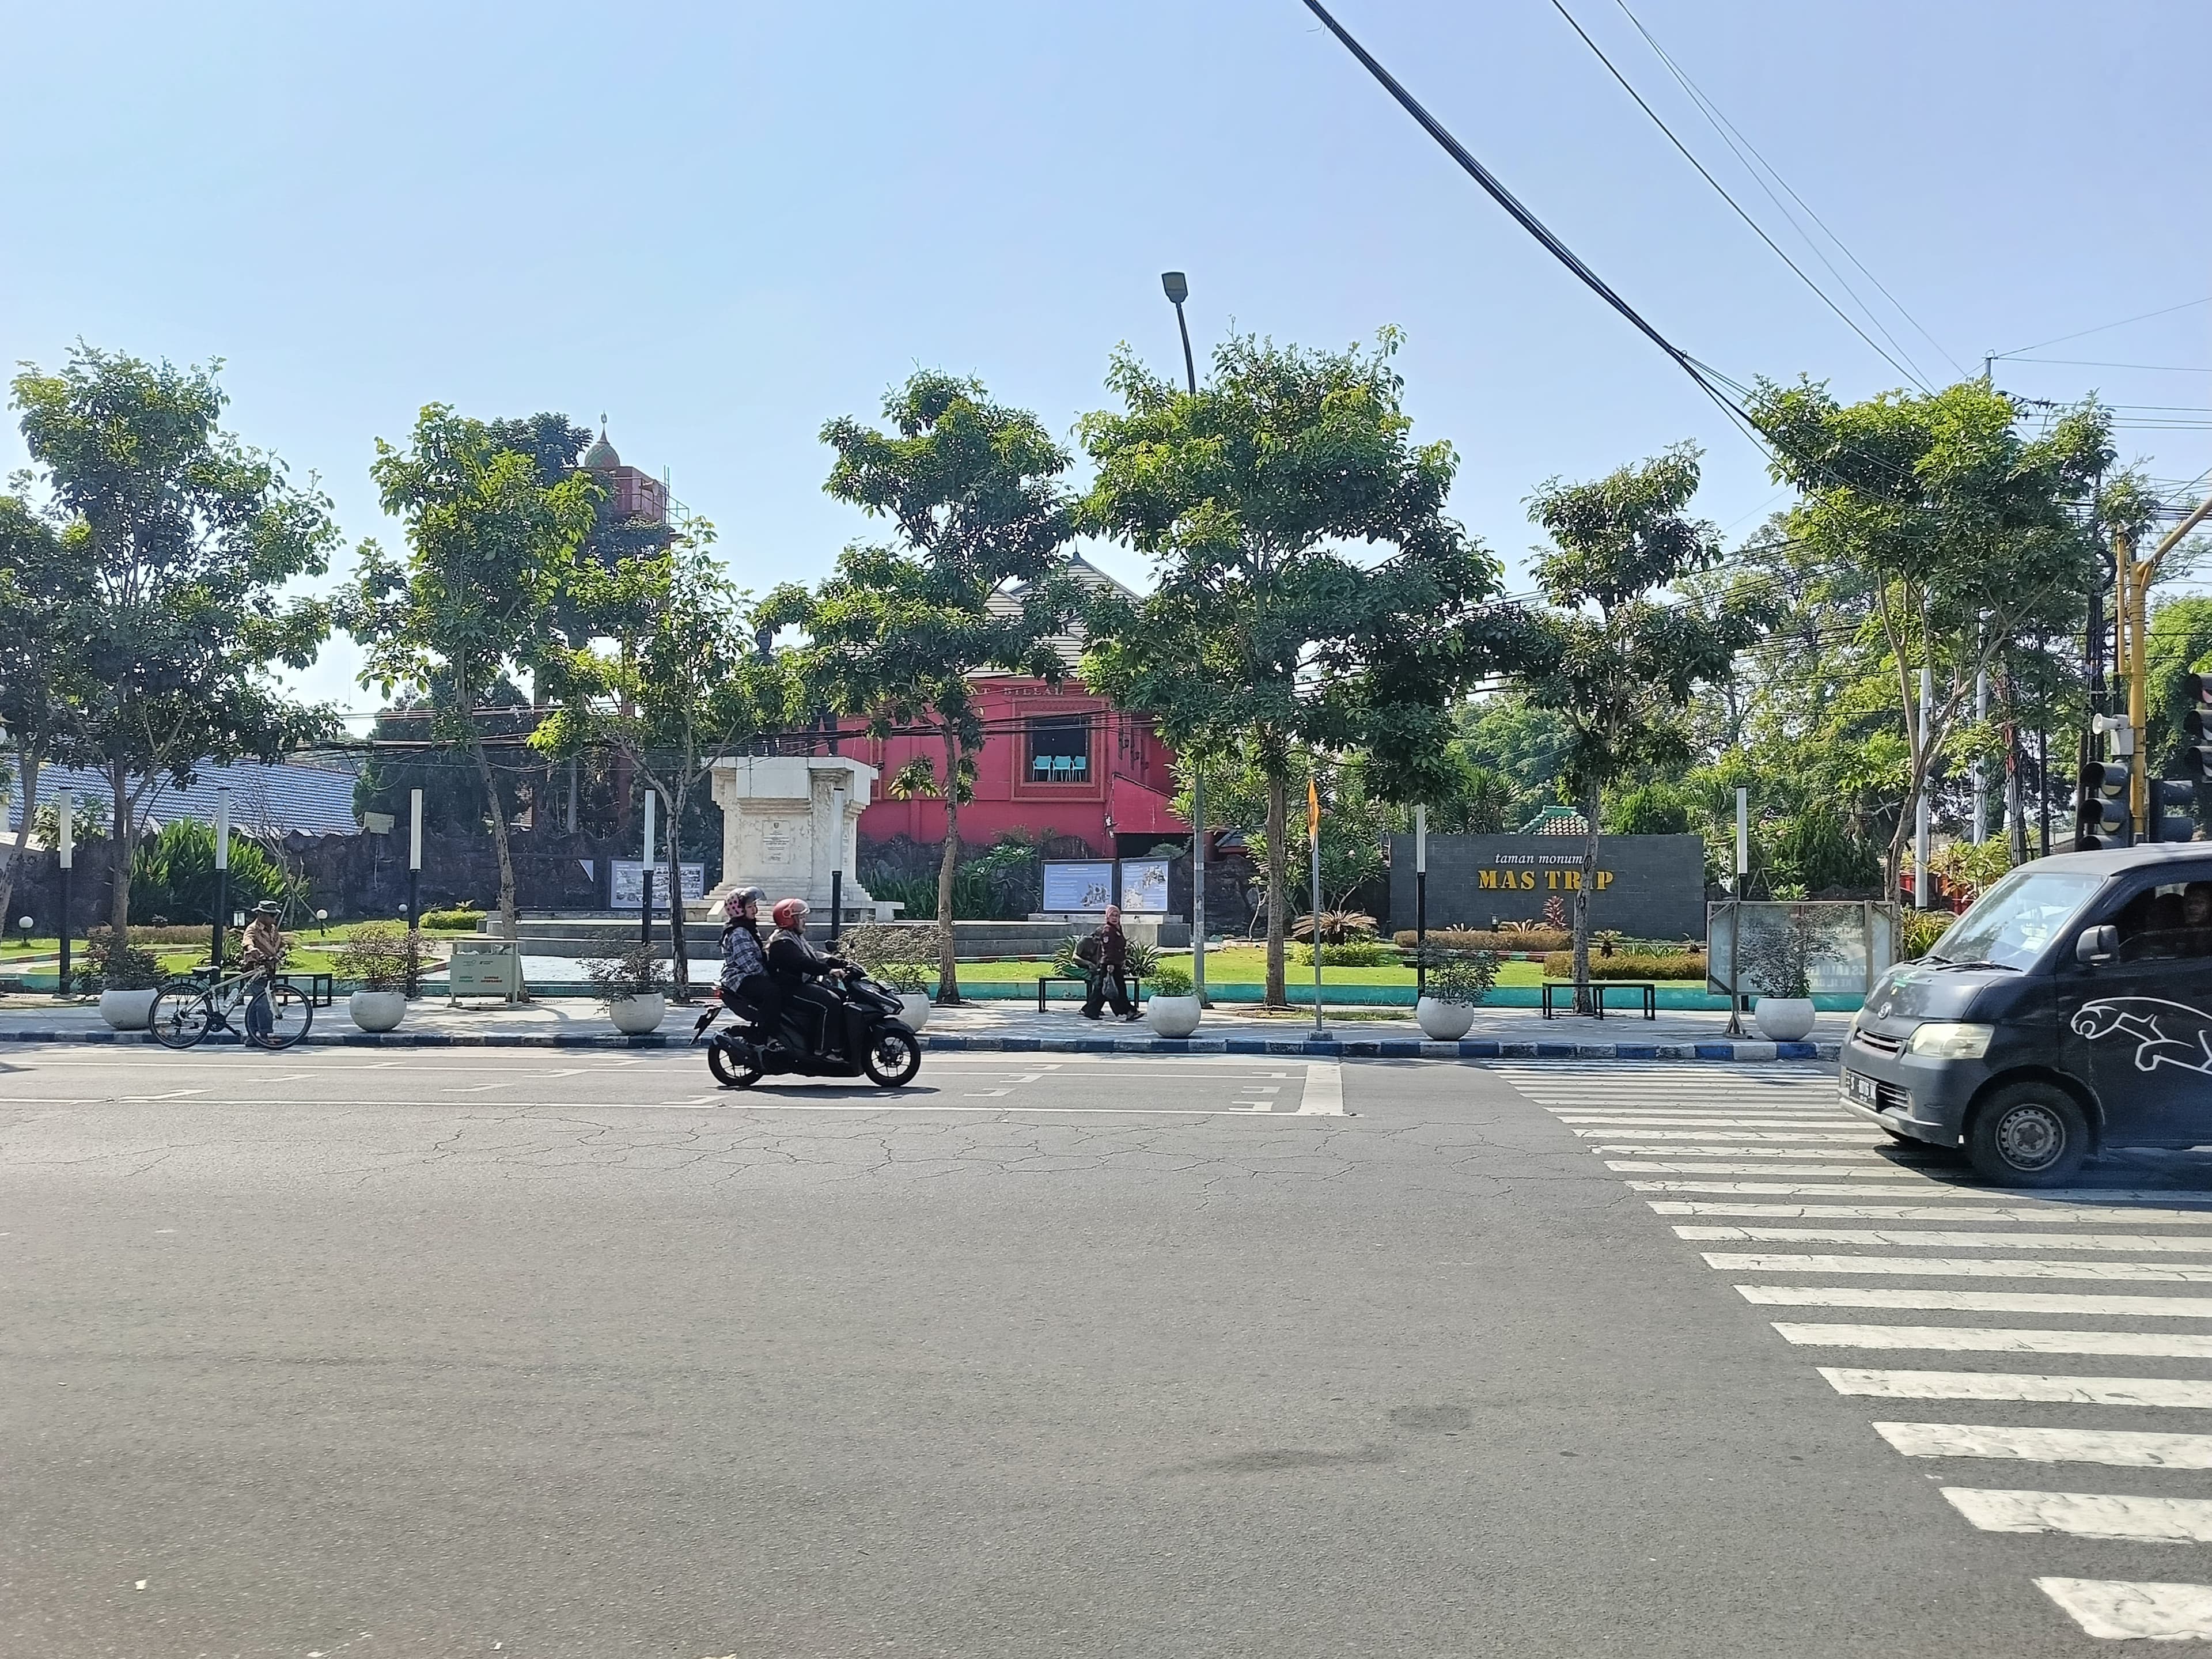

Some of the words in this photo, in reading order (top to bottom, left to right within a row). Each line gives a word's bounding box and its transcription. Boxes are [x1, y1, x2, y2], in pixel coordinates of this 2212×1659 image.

[1495, 854, 1534, 864] taman
[1539, 855, 1584, 864] monum
[1478, 870, 1535, 889] MAS
[1544, 870, 1613, 890] TRP
